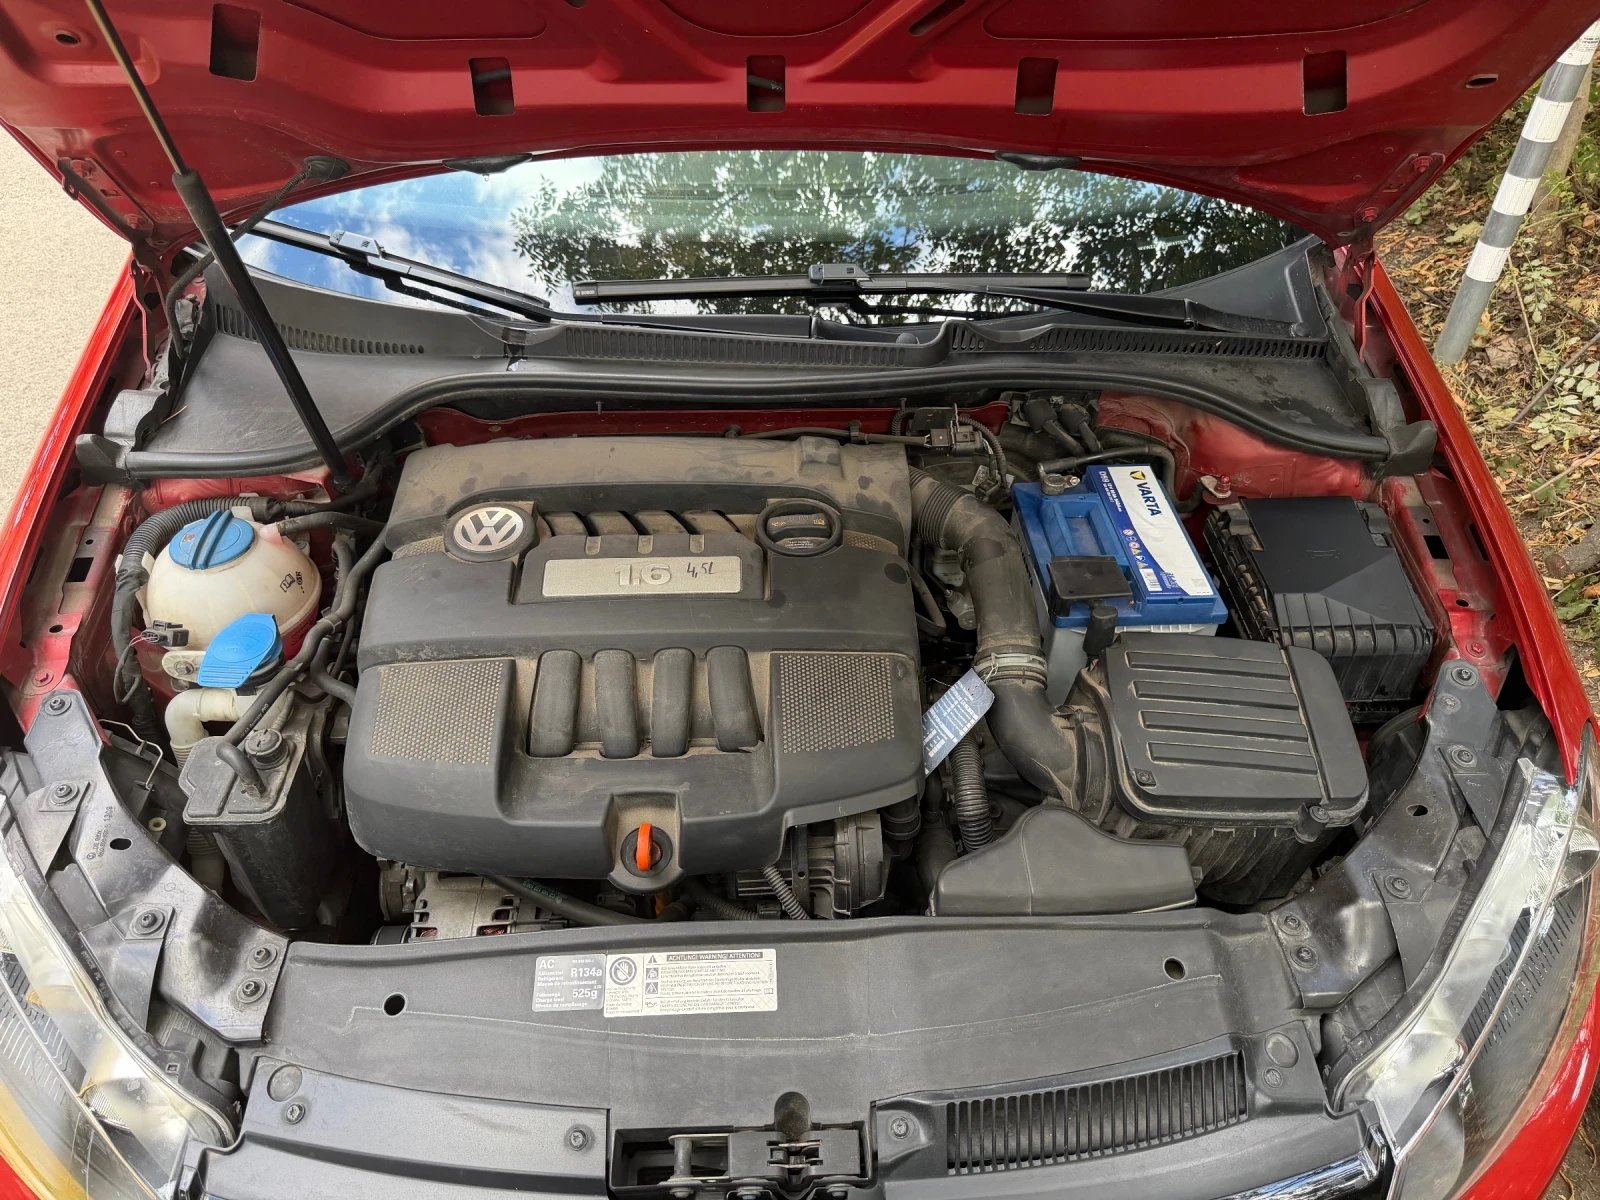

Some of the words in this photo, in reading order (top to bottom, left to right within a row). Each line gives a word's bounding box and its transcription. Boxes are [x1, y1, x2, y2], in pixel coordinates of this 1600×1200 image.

[1136, 482, 1162, 516] VARTA
[614, 563, 671, 586] 1.6
[686, 561, 717, 578] 4,5L
[539, 959, 555, 969] AC
[571, 967, 603, 978] R134a
[572, 988, 598, 1000] 525g
